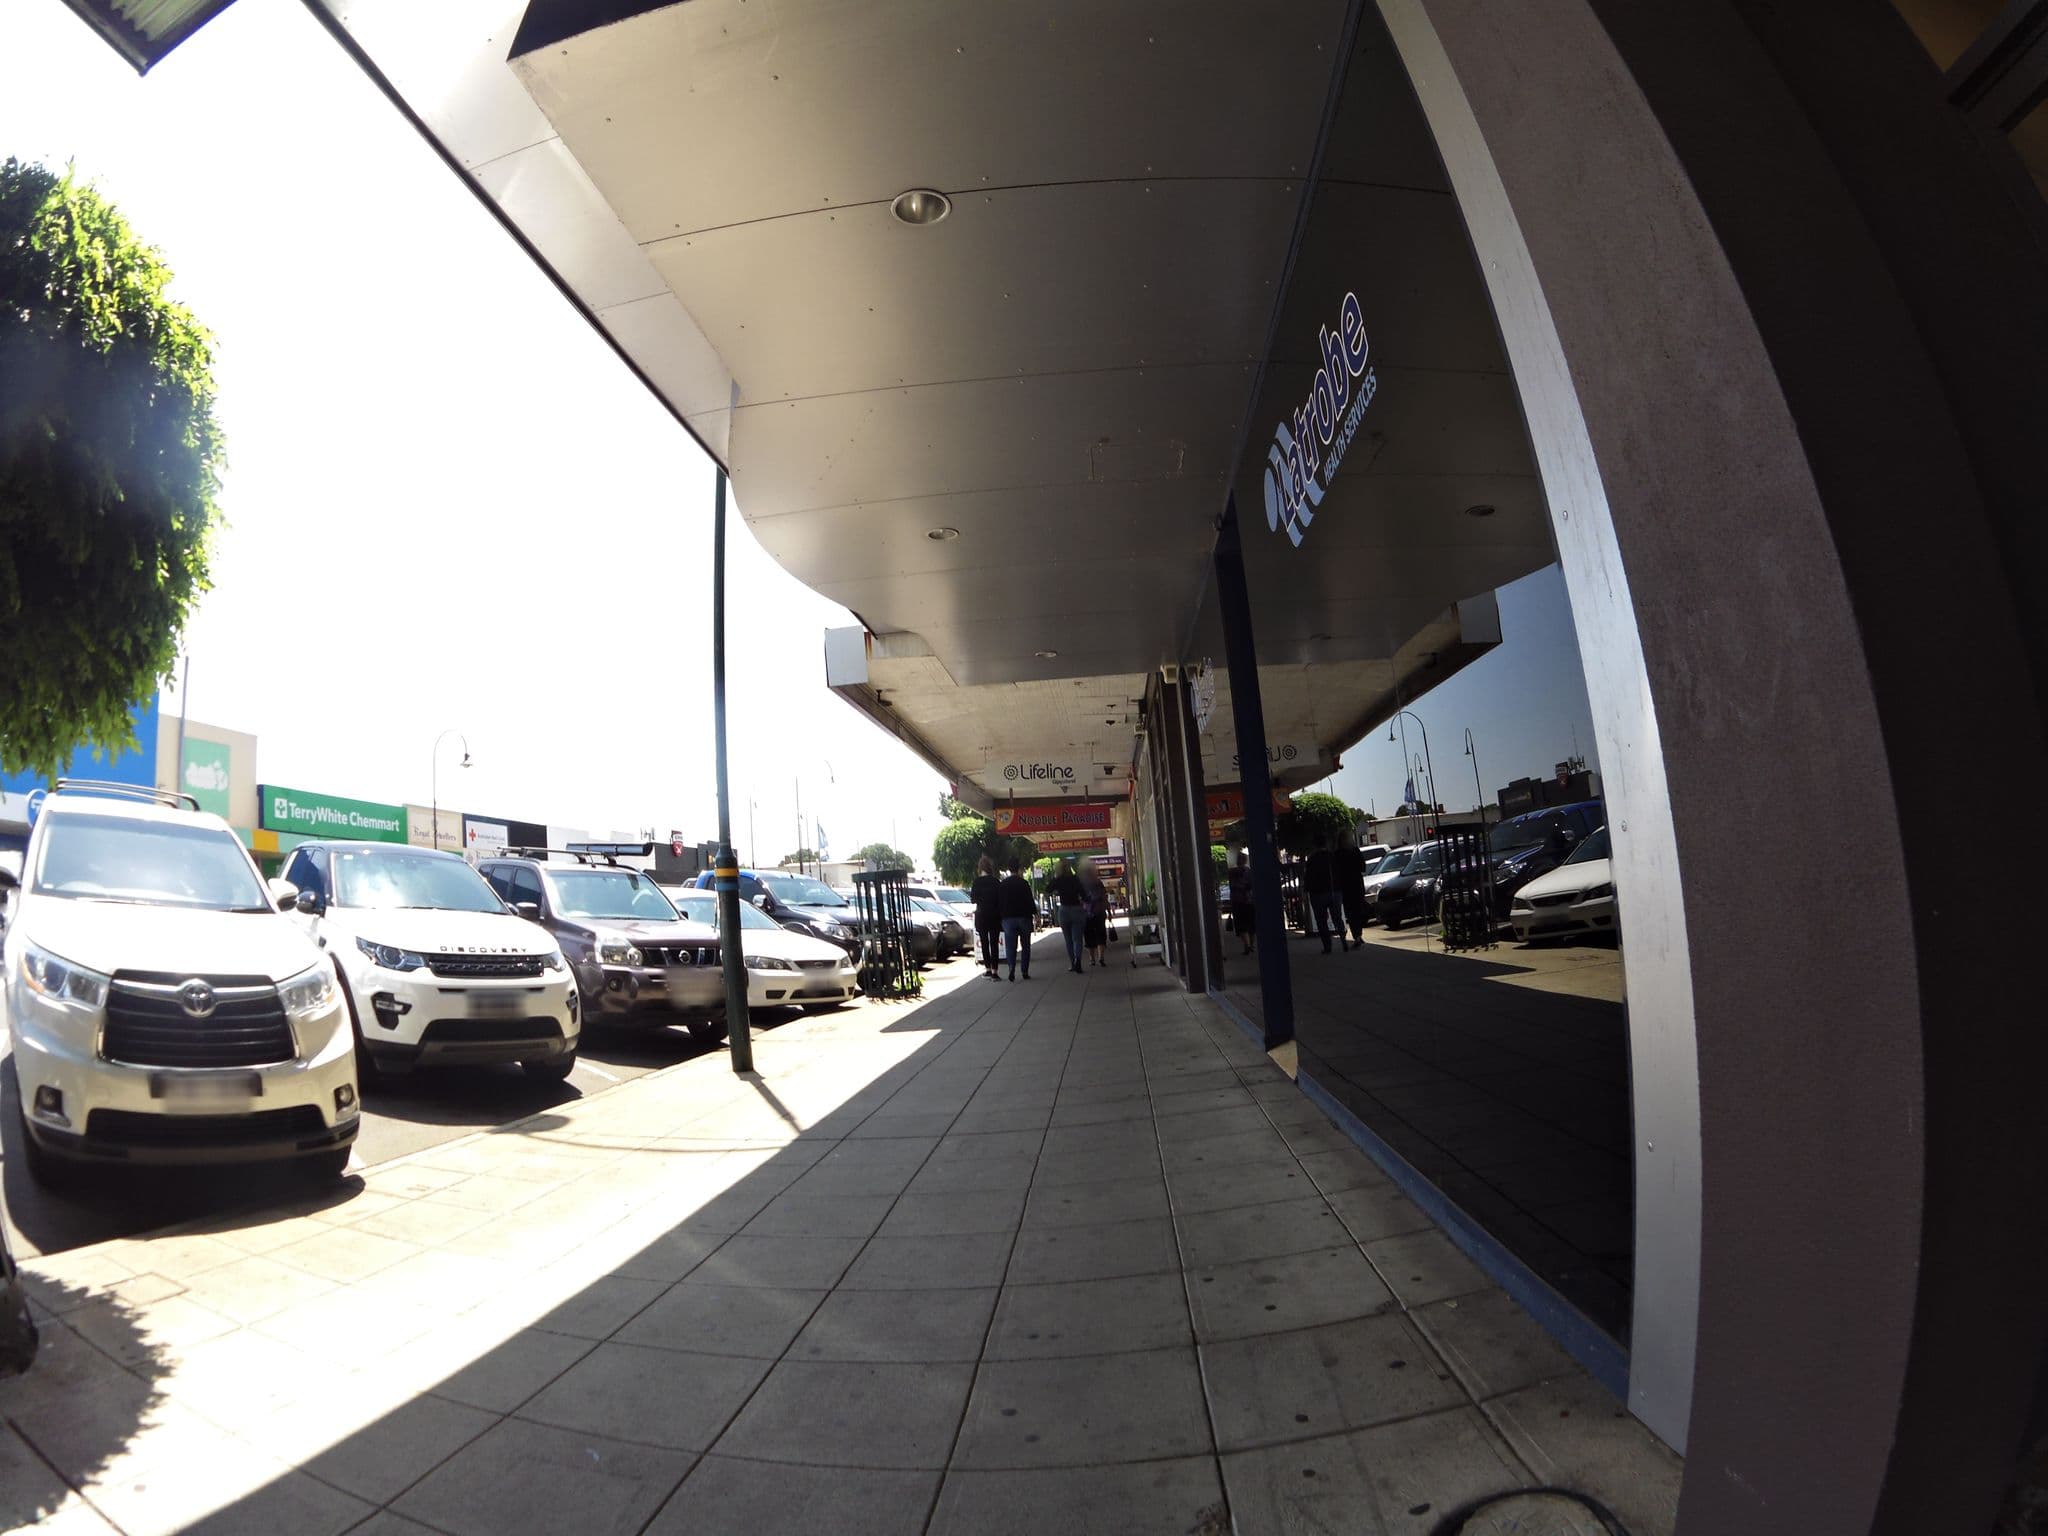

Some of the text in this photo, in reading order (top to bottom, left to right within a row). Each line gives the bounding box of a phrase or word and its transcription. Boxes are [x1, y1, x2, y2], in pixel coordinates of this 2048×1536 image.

[1276, 291, 1369, 532] Latrobe
[1323, 366, 1377, 486] HEALTH SERVICES
[1020, 763, 1074, 779] Lifeline
[289, 802, 400, 832] TerryWhite Chemmart
